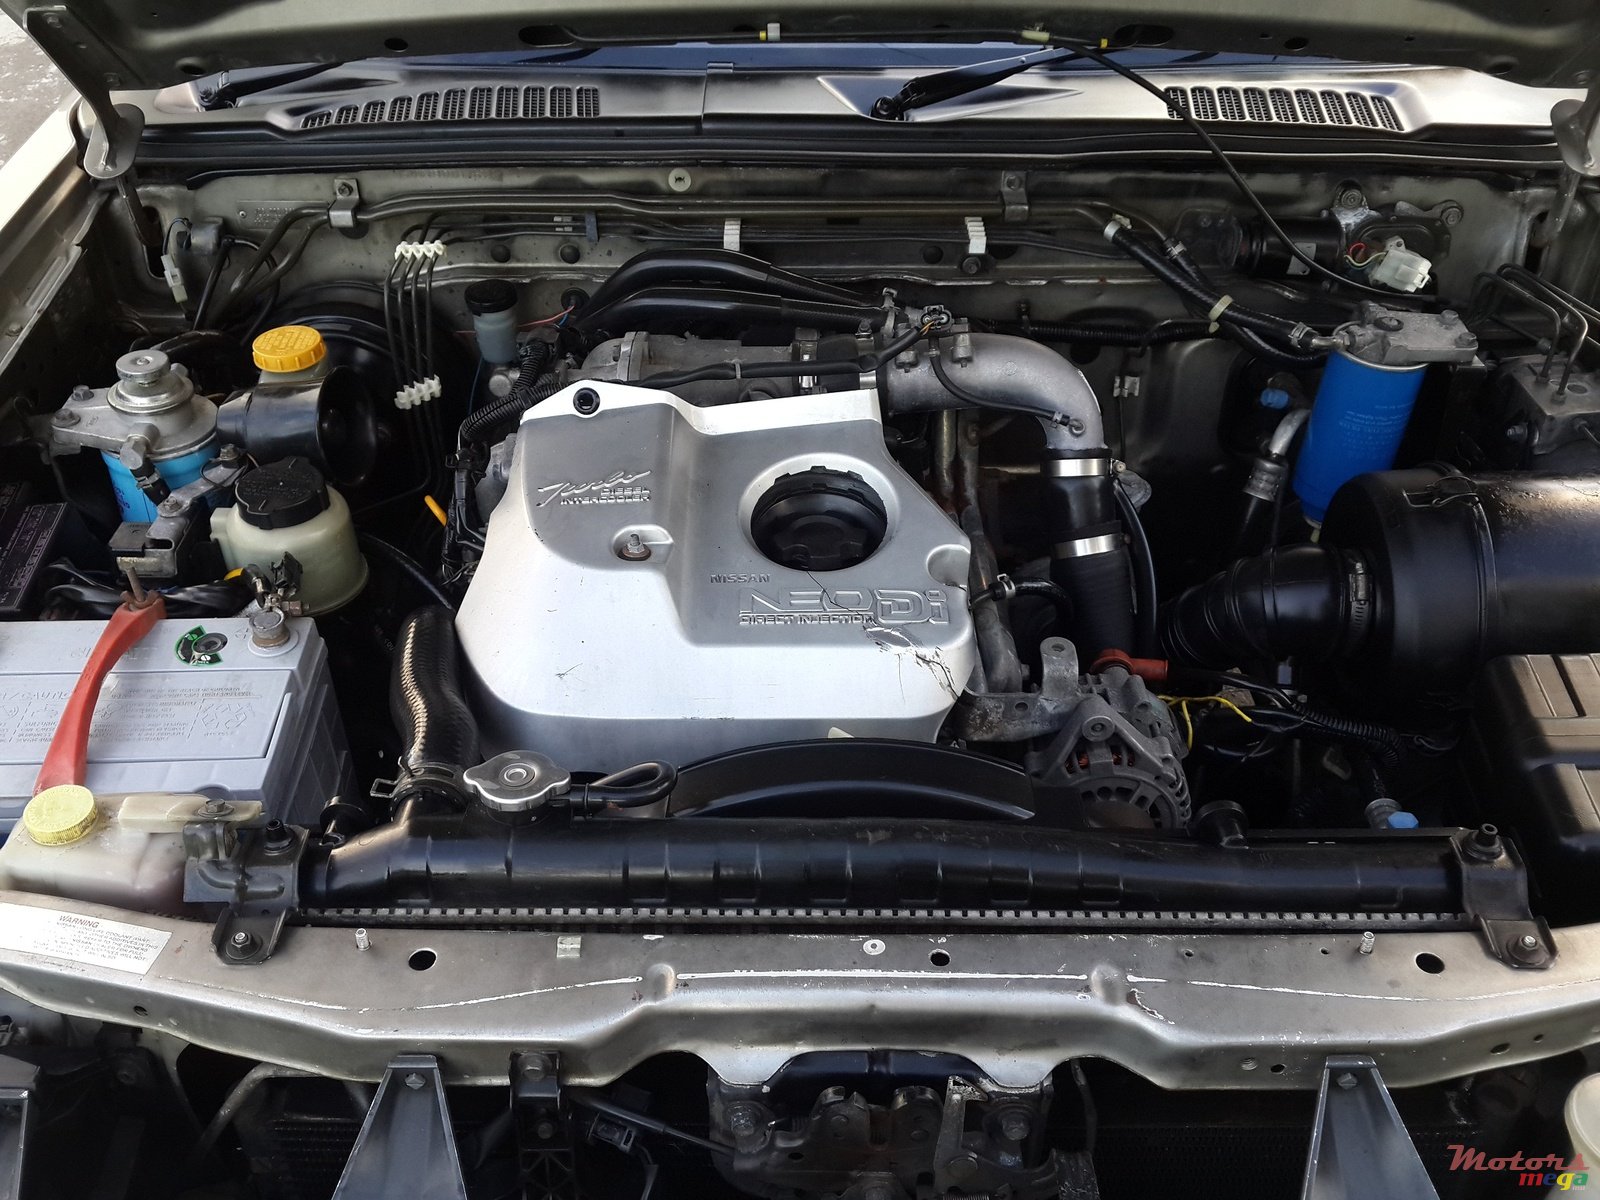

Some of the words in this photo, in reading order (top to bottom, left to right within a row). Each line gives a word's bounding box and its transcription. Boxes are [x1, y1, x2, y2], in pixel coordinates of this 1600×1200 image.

[600, 487, 650, 496] DIESEL
[560, 494, 650, 505] INTERCOOLER
[710, 573, 771, 584] NISSAN
[739, 614, 795, 626] DIRECT
[797, 613, 875, 626] INJECTION
[59, 915, 99, 928] WARNING
